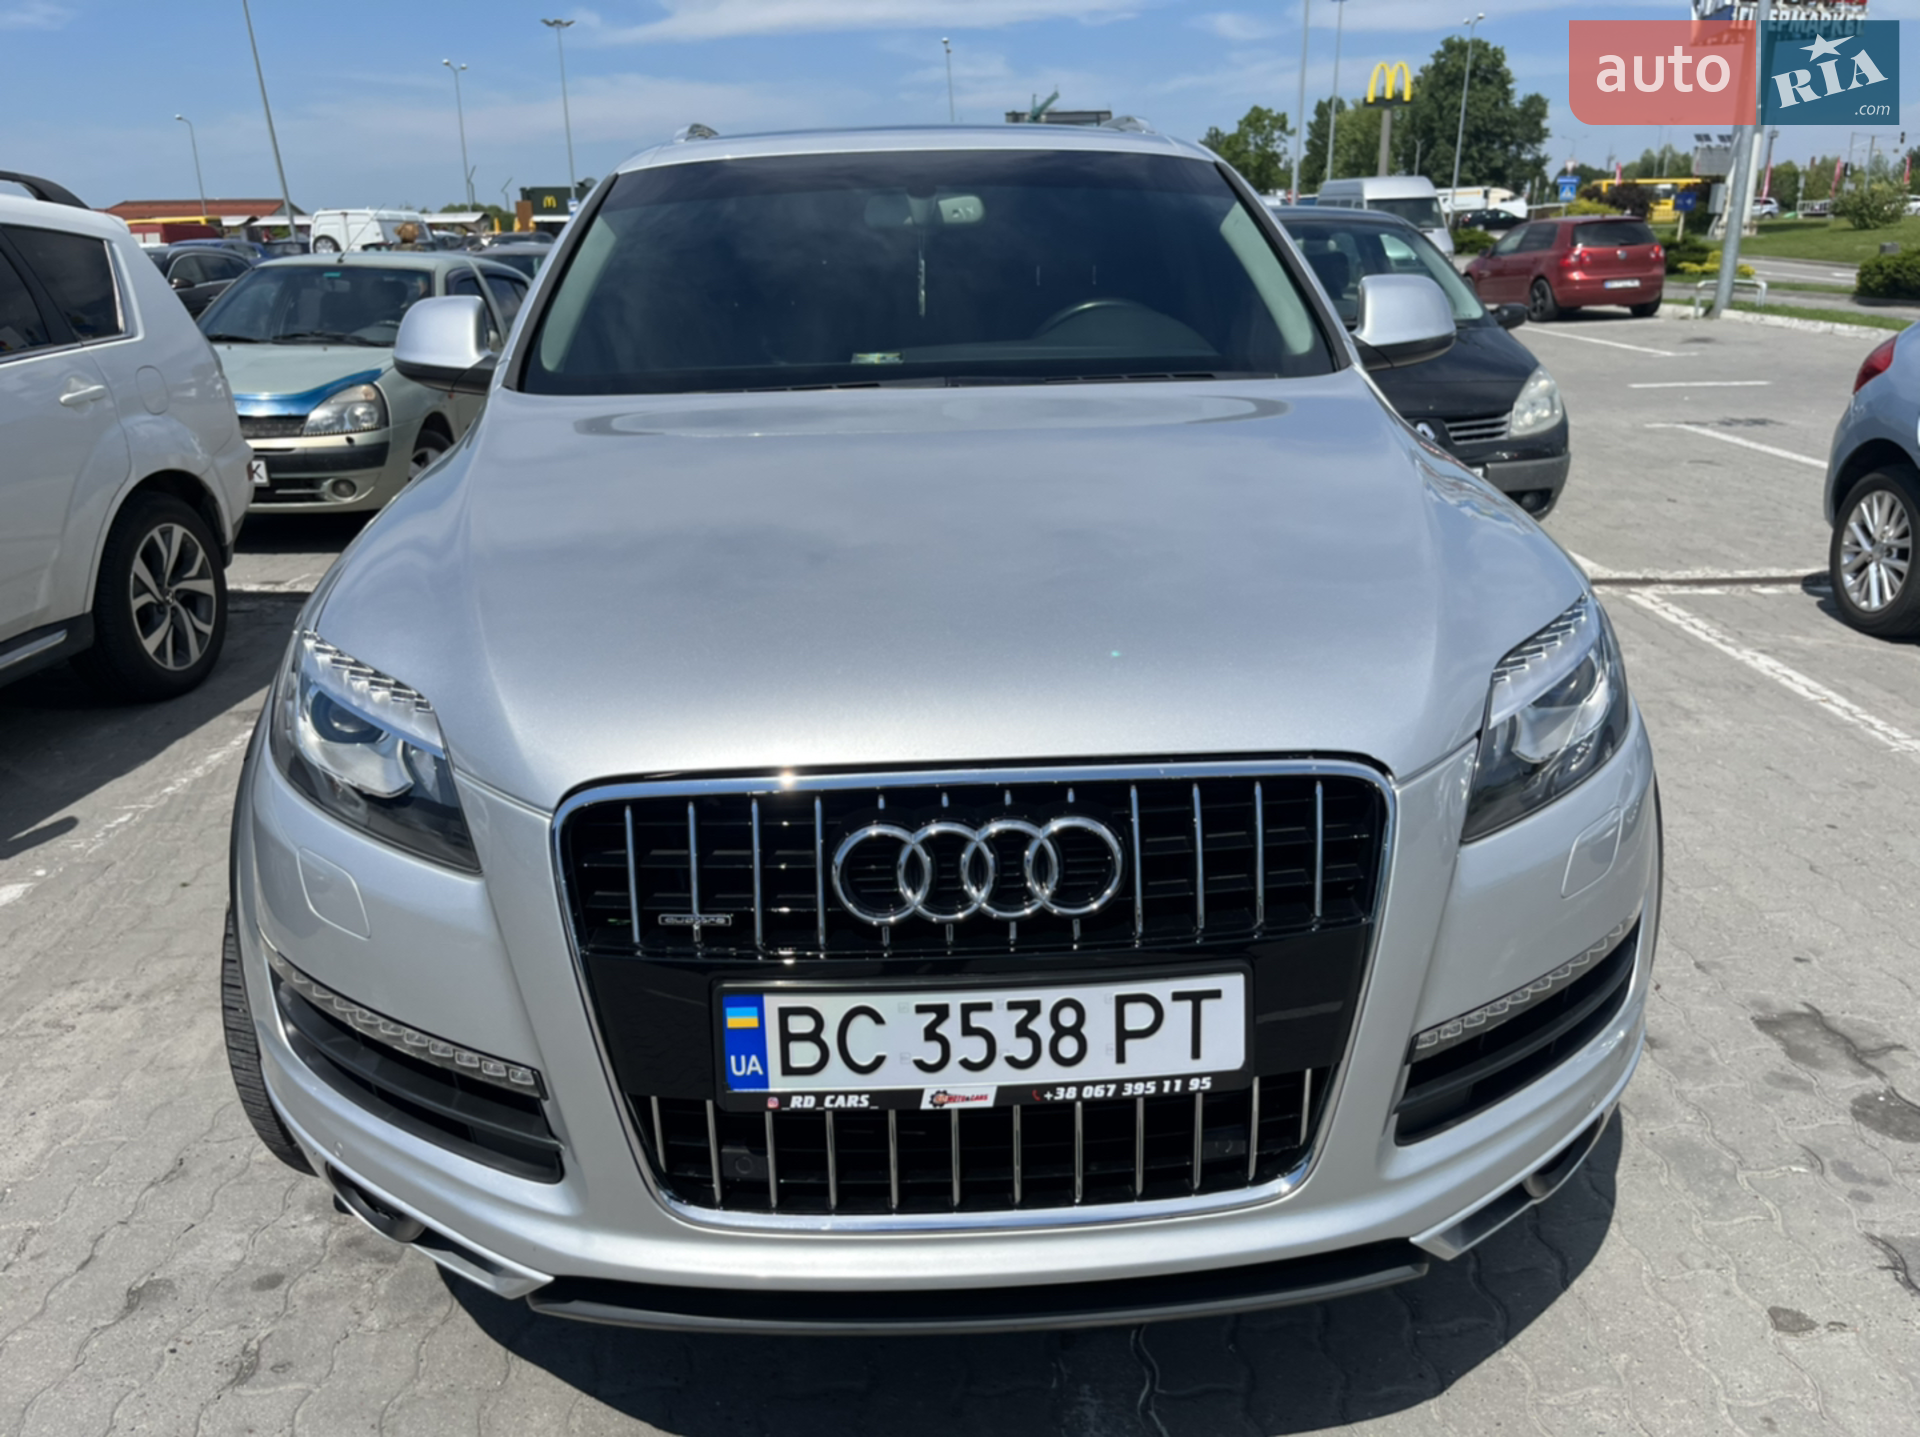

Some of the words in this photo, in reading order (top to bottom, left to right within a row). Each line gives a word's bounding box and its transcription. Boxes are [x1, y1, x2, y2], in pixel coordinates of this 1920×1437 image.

[777, 1005, 888, 1077] BC
[911, 997, 1088, 1074] 3538
[1114, 989, 1223, 1065] PT
[730, 1055, 764, 1077] UA
[1044, 1086, 1077, 1101] +38
[1082, 1084, 1116, 1098] 067
[1121, 1081, 1156, 1097] 395
[1162, 1079, 1182, 1094] 11
[1188, 1076, 1212, 1091] 95
